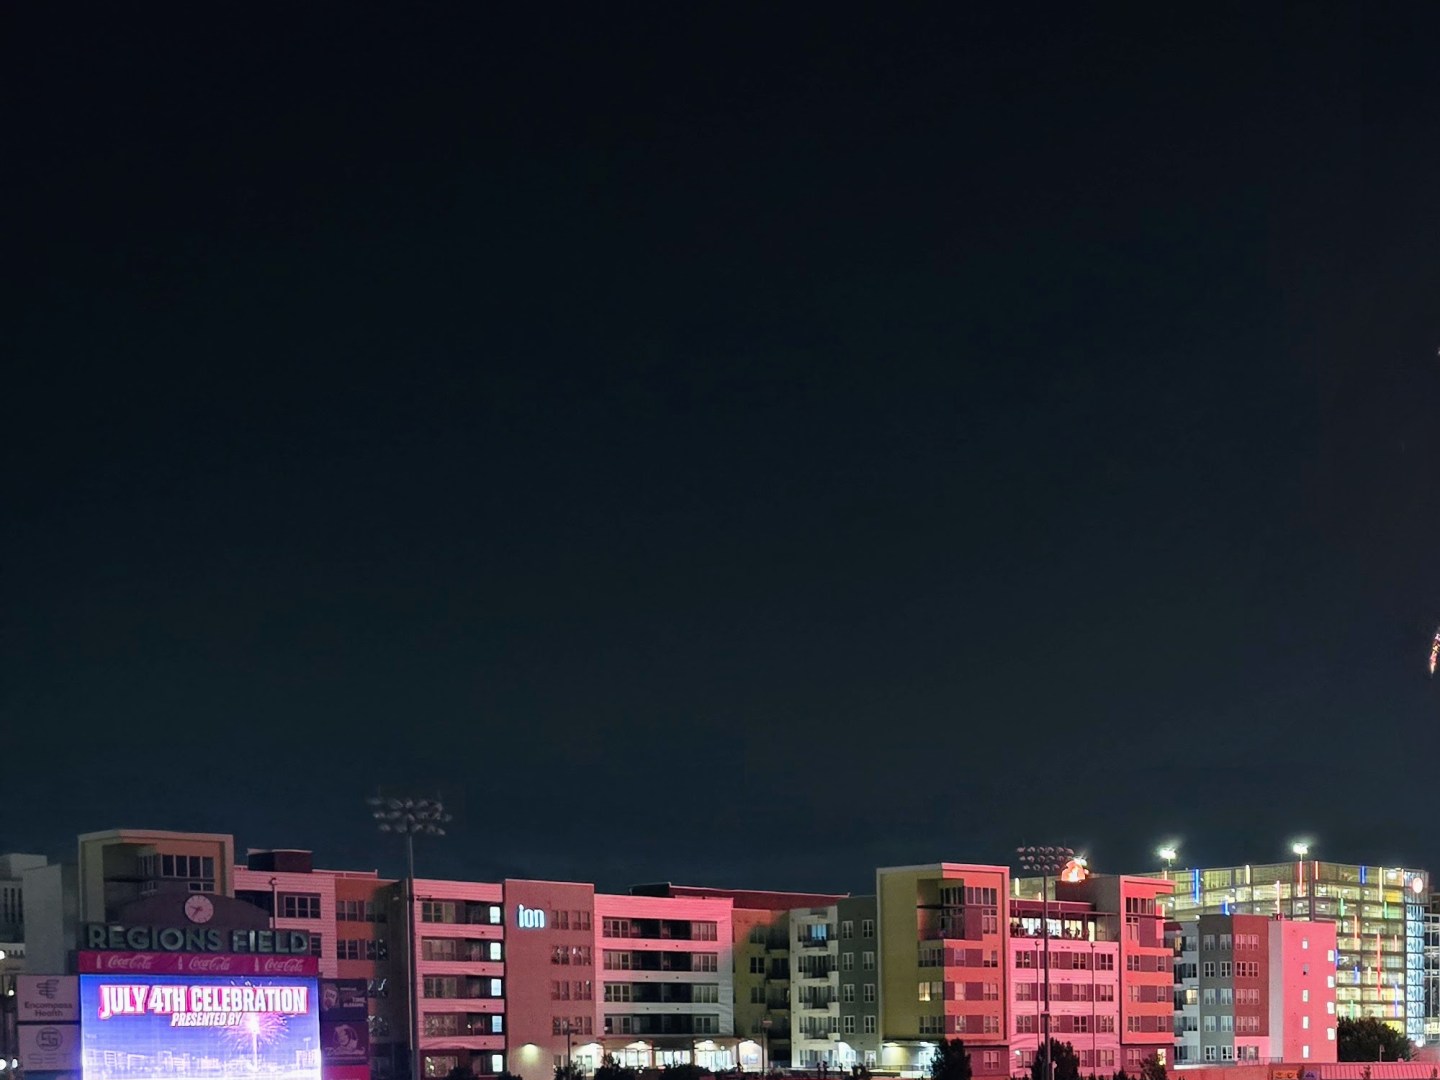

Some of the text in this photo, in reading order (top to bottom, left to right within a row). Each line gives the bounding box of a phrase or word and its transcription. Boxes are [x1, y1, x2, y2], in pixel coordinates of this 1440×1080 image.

[518, 903, 545, 928] ion
[88, 925, 308, 953] REGIONS FIELD
[24, 1002, 72, 1010] Encompass
[98, 985, 307, 1019] JULY 4TH CELEBRATION
[171, 1012, 243, 1028] PRESENTED BY
